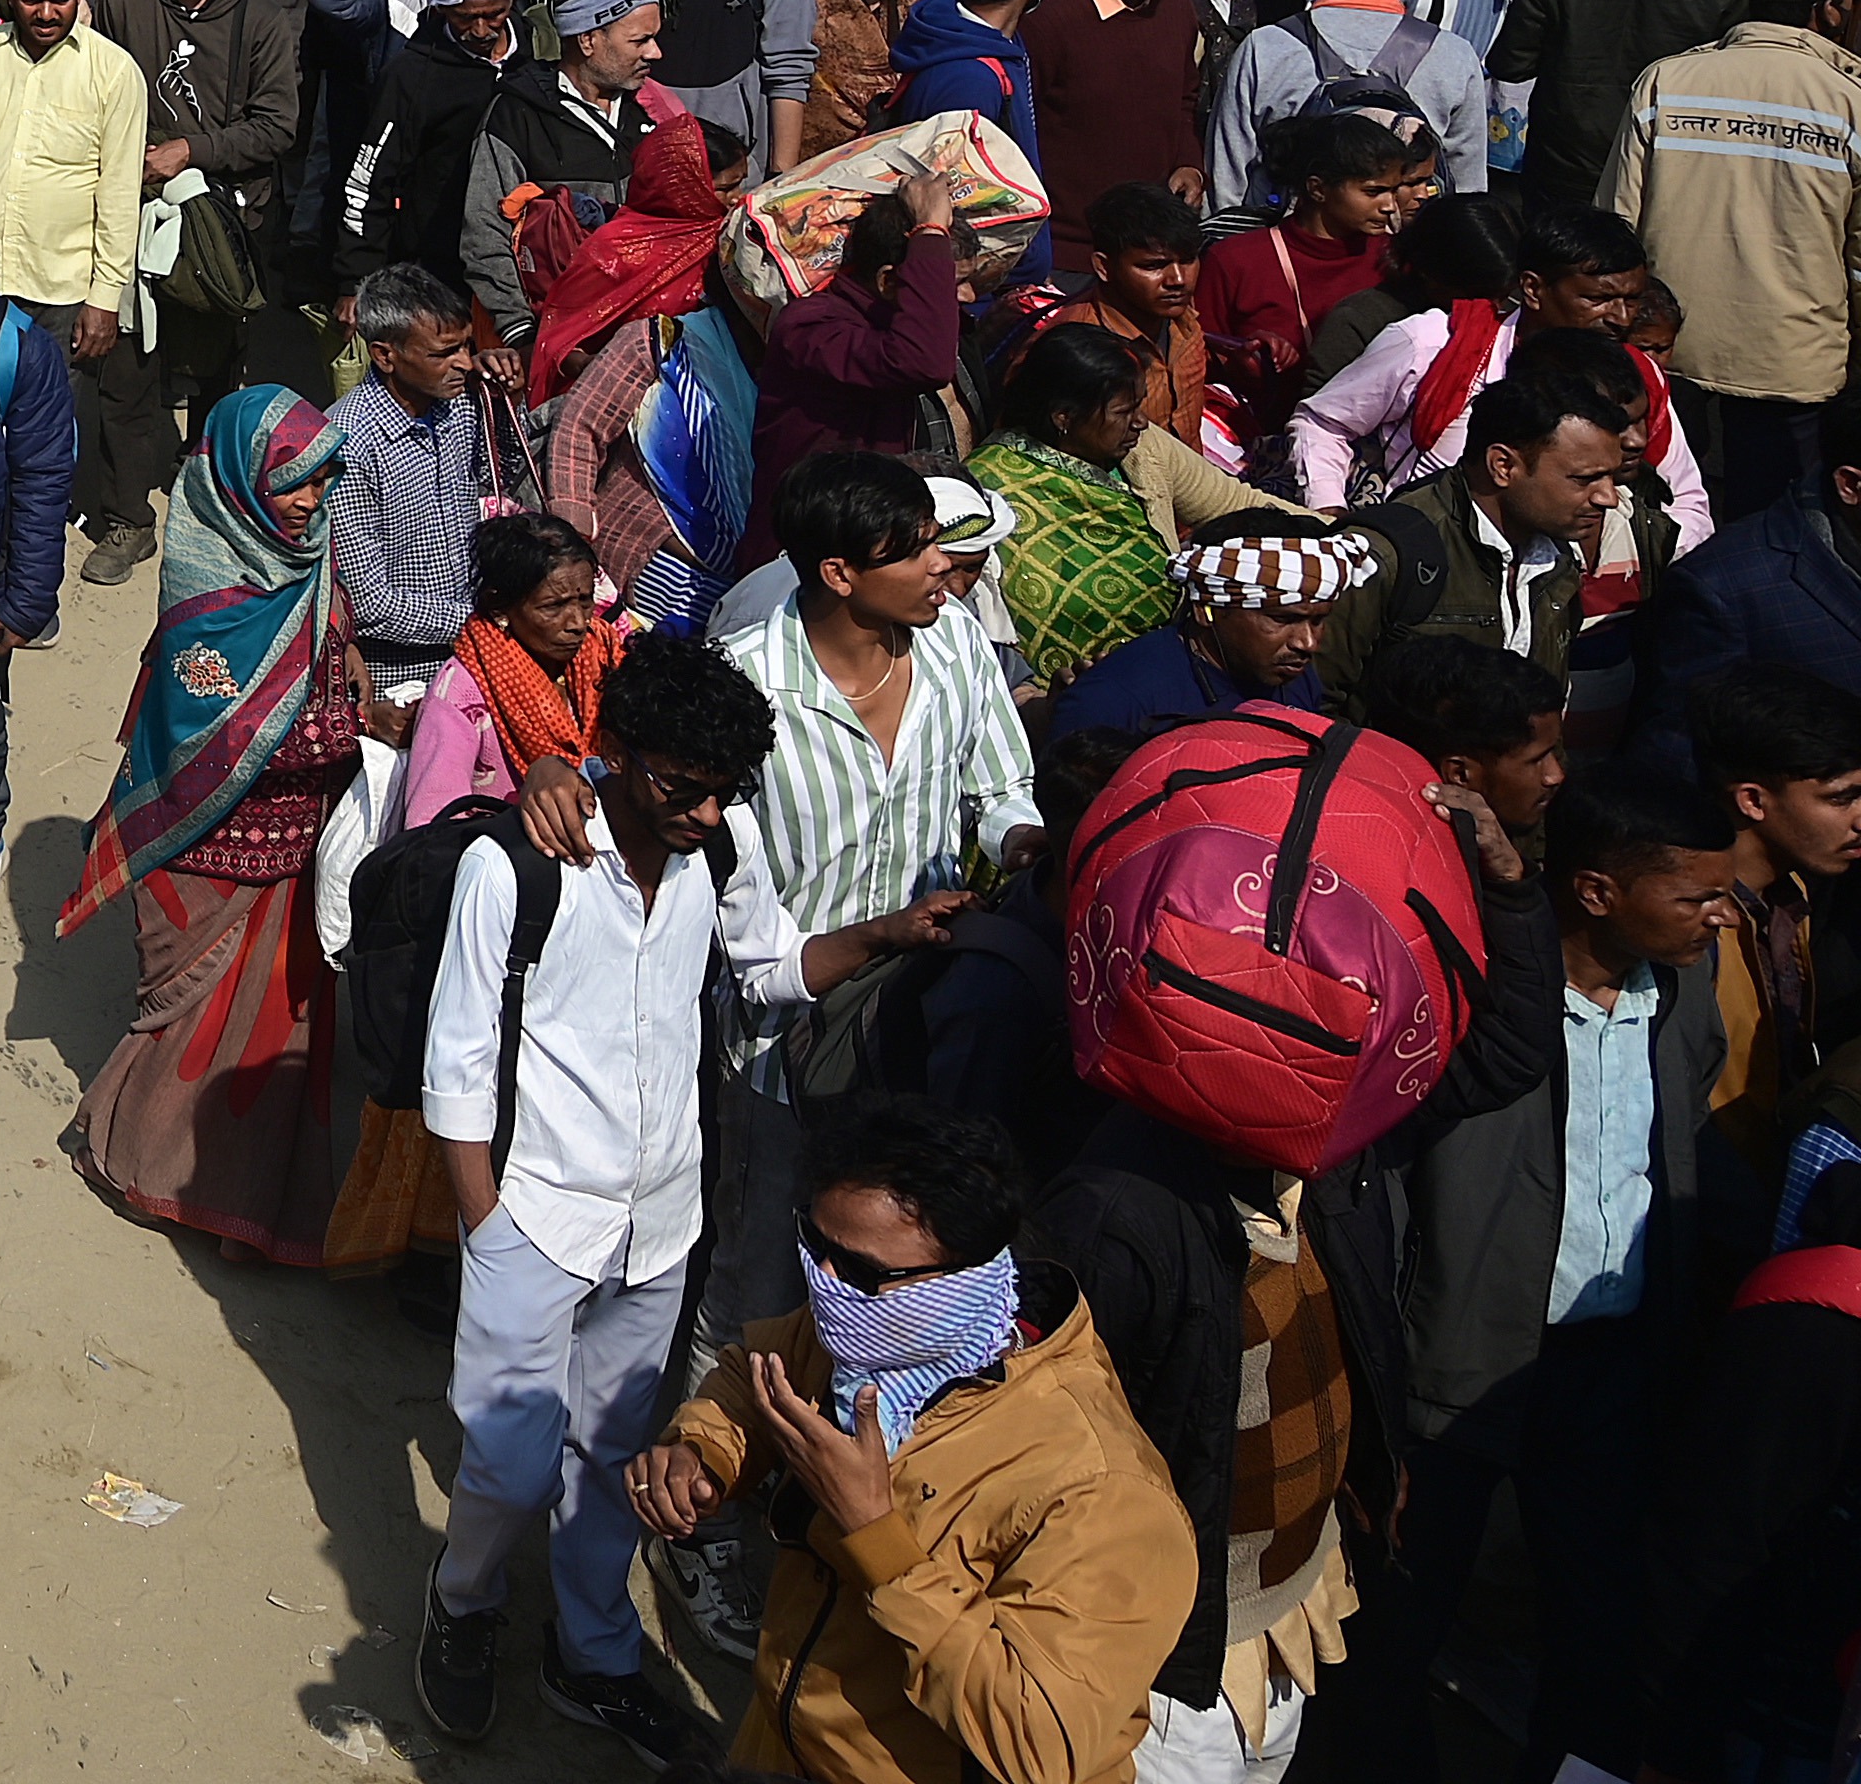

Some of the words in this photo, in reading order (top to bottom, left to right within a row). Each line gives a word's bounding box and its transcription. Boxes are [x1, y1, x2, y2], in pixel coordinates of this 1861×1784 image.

[1665, 114, 1721, 134] उत्तर
[1726, 114, 1777, 139] प्रदेश
[1780, 123, 1840, 152] पुलिस
